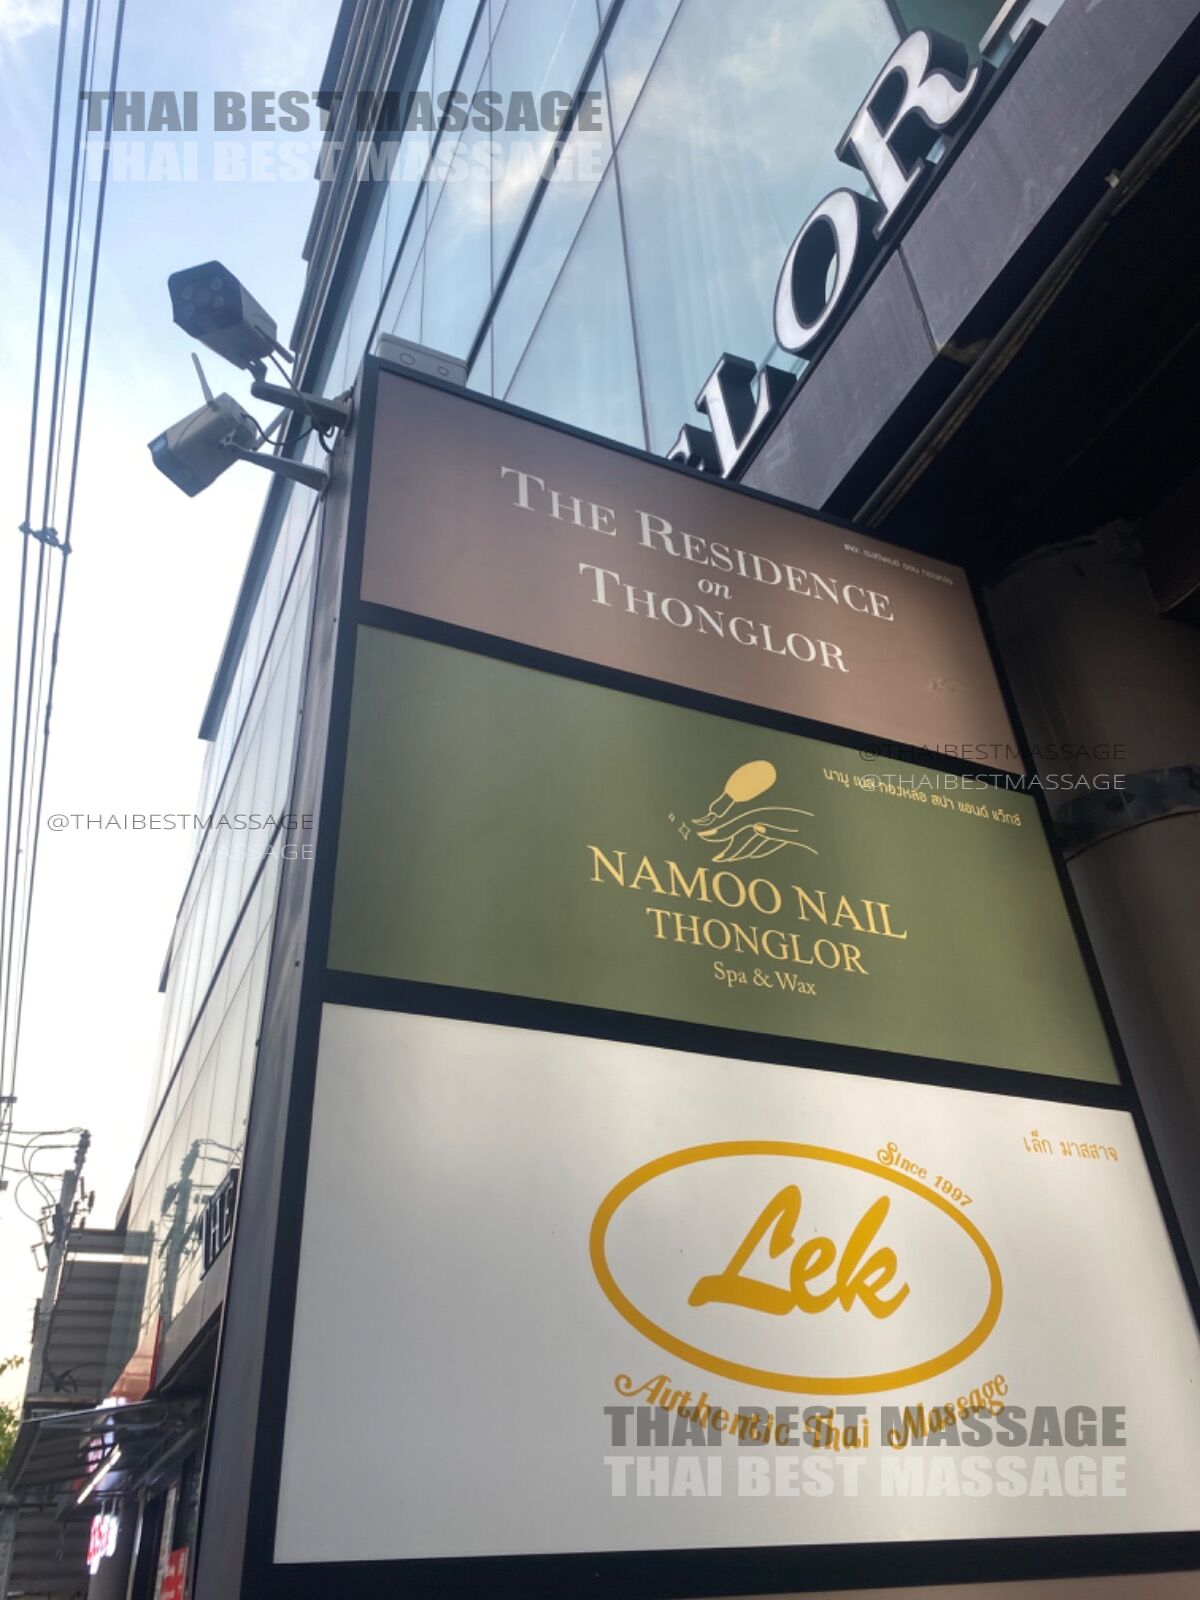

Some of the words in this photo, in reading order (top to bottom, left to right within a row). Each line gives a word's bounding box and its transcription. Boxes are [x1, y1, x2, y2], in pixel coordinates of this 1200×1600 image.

[501, 466, 617, 537] THE
[635, 509, 894, 622] RESIDENCE
[579, 563, 849, 673] THONGLOR
[698, 577, 732, 600] on
[587, 845, 781, 914] NAMOO
[792, 885, 908, 939] NAIL
[646, 907, 869, 975] THONGLOR
[713, 961, 748, 987] Spa
[753, 969, 773, 988] &
[774, 972, 817, 996] Wax
[877, 1142, 927, 1179] Since
[934, 1175, 973, 1206] 1997
[688, 1185, 909, 1318] Lek
[614, 1374, 790, 1445] Authentic
[805, 1407, 869, 1451] Thai
[887, 1374, 1008, 1450] Massage
